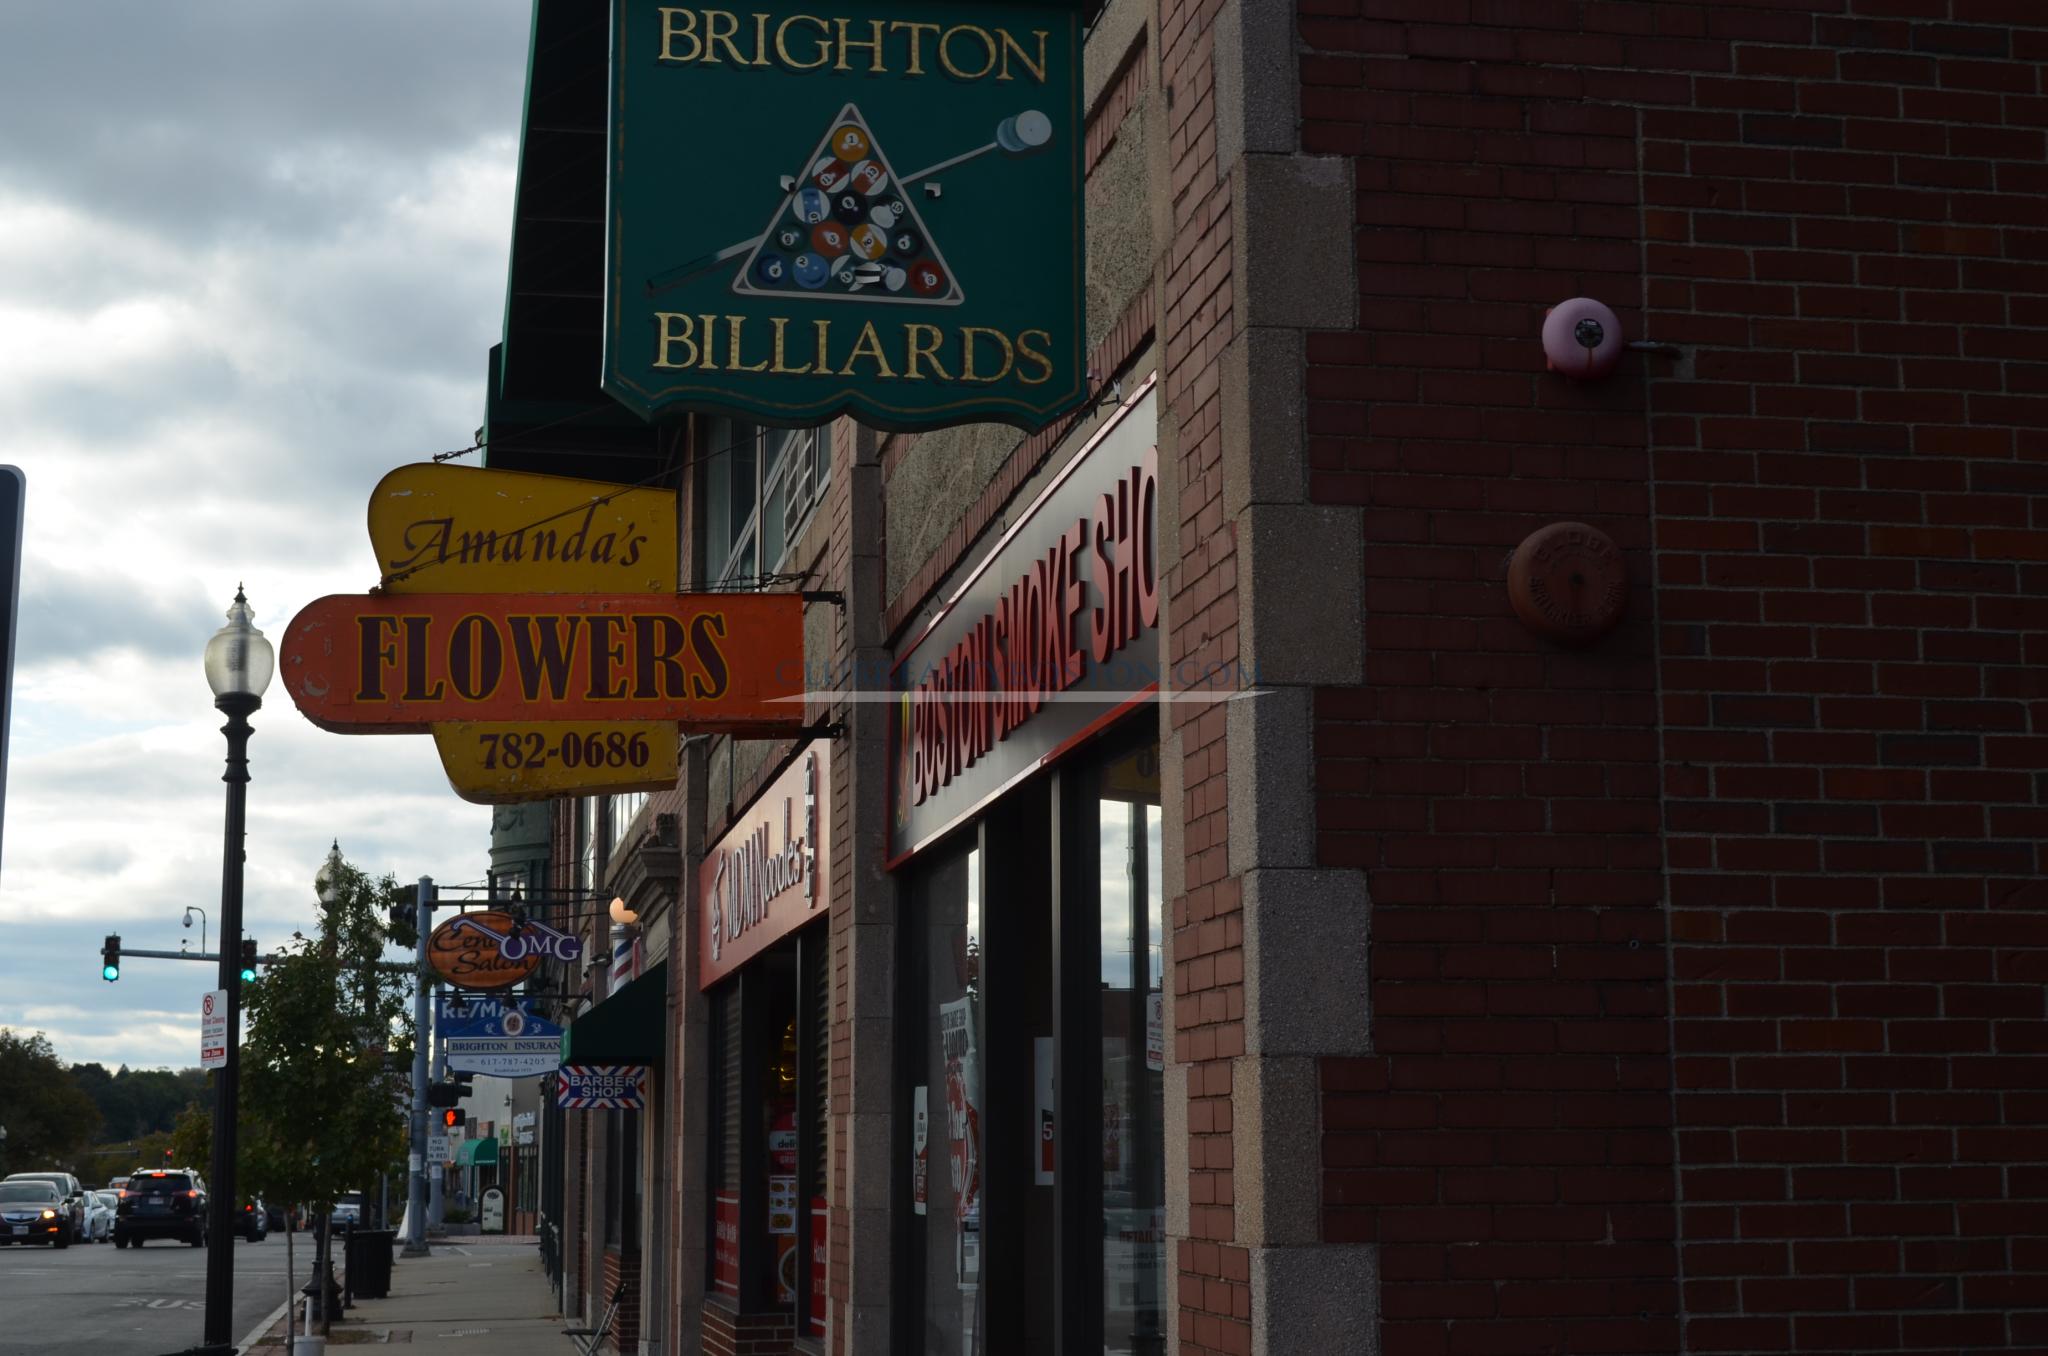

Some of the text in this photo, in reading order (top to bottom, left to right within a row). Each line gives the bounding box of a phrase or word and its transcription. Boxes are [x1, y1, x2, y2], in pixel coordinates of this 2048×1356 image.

[658, 7, 1049, 84] BRIGHTON
[652, 311, 1054, 385] BILLIARDS
[390, 498, 648, 568] Amanda's
[354, 612, 730, 704] FLOWERS
[913, 613, 993, 806] BOSTON
[992, 518, 1087, 742] SMOKE
[479, 731, 650, 770] 782-0686
[756, 797, 804, 918] Noodles
[500, 935, 580, 961] OMG
[452, 1042, 508, 1051] BRIGHTON
[570, 1076, 636, 1087] BARBER
[581, 1086, 625, 1097] SHOP
